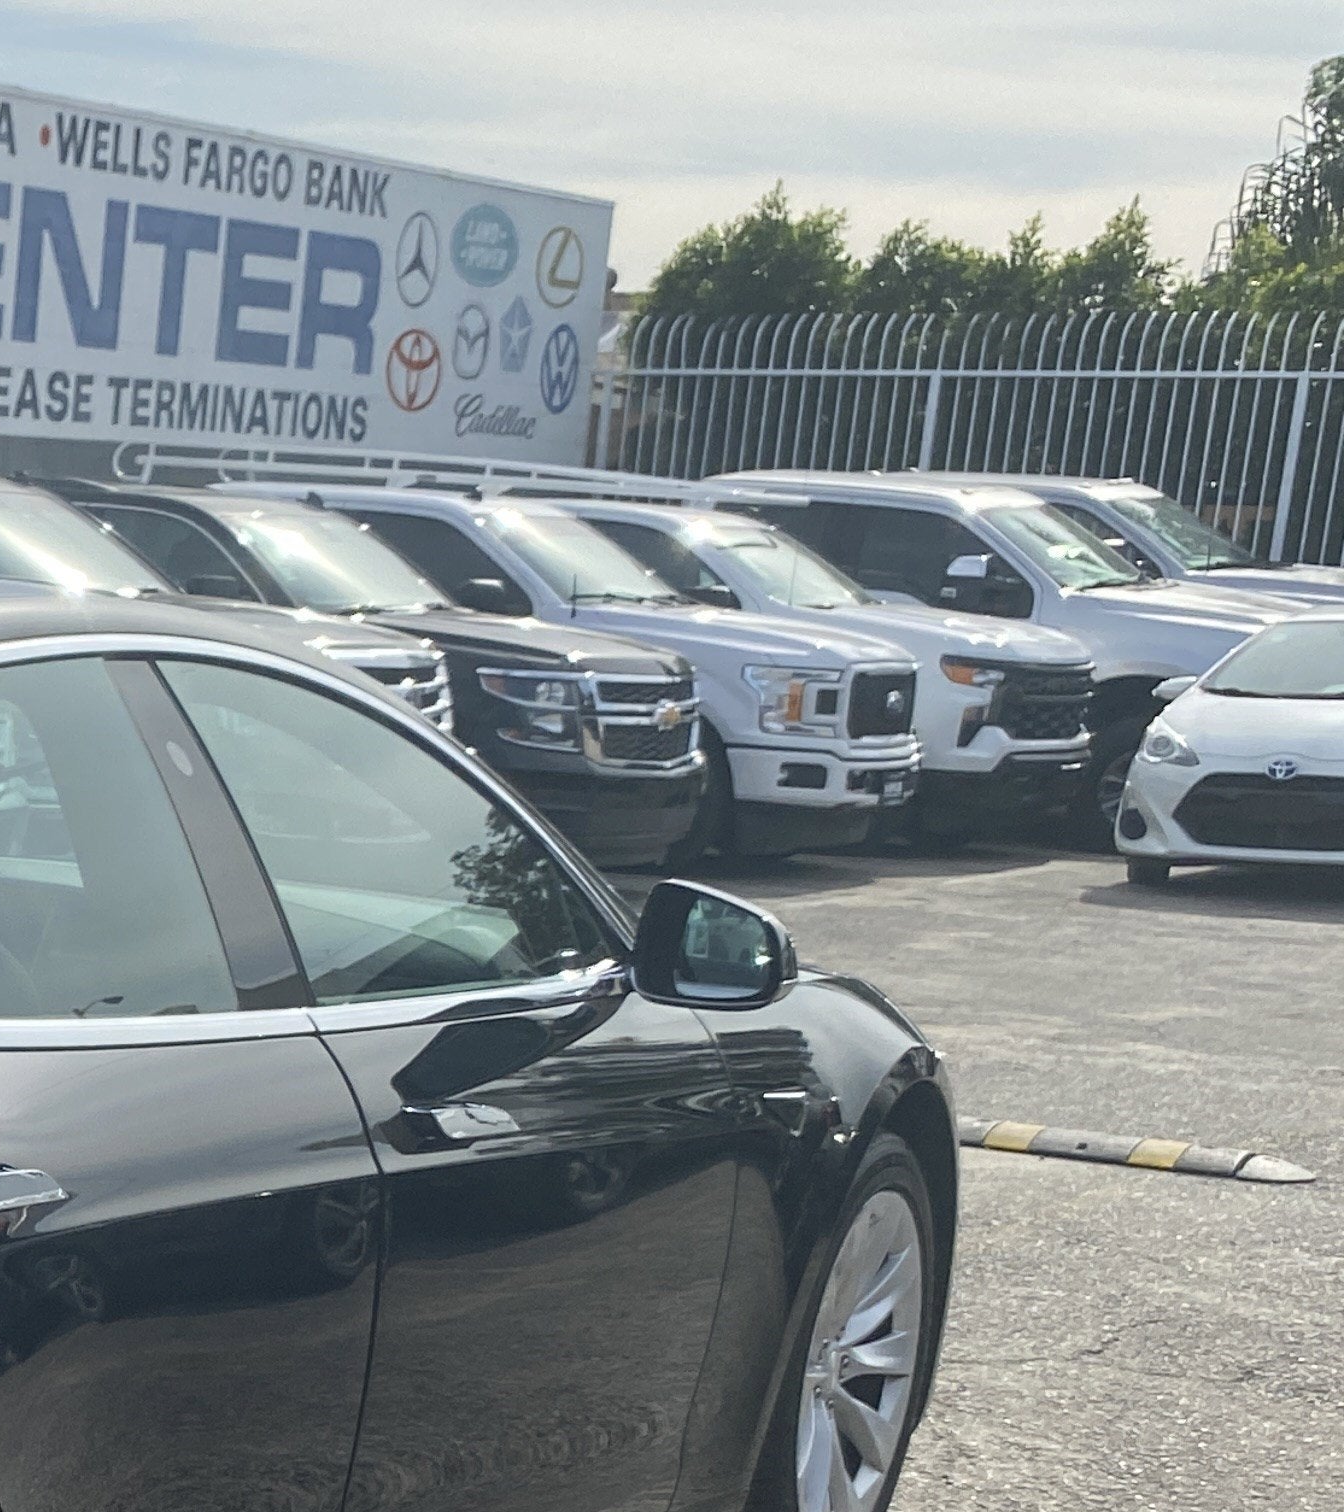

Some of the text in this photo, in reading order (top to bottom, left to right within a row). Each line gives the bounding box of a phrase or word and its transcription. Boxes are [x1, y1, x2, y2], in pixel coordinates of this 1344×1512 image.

[55, 111, 172, 181] WELLS
[182, 137, 295, 201] FARGO
[304, 158, 390, 219] BANK
[107, 376, 369, 443] TERMINATIONS
[454, 393, 537, 440] Cadillac
